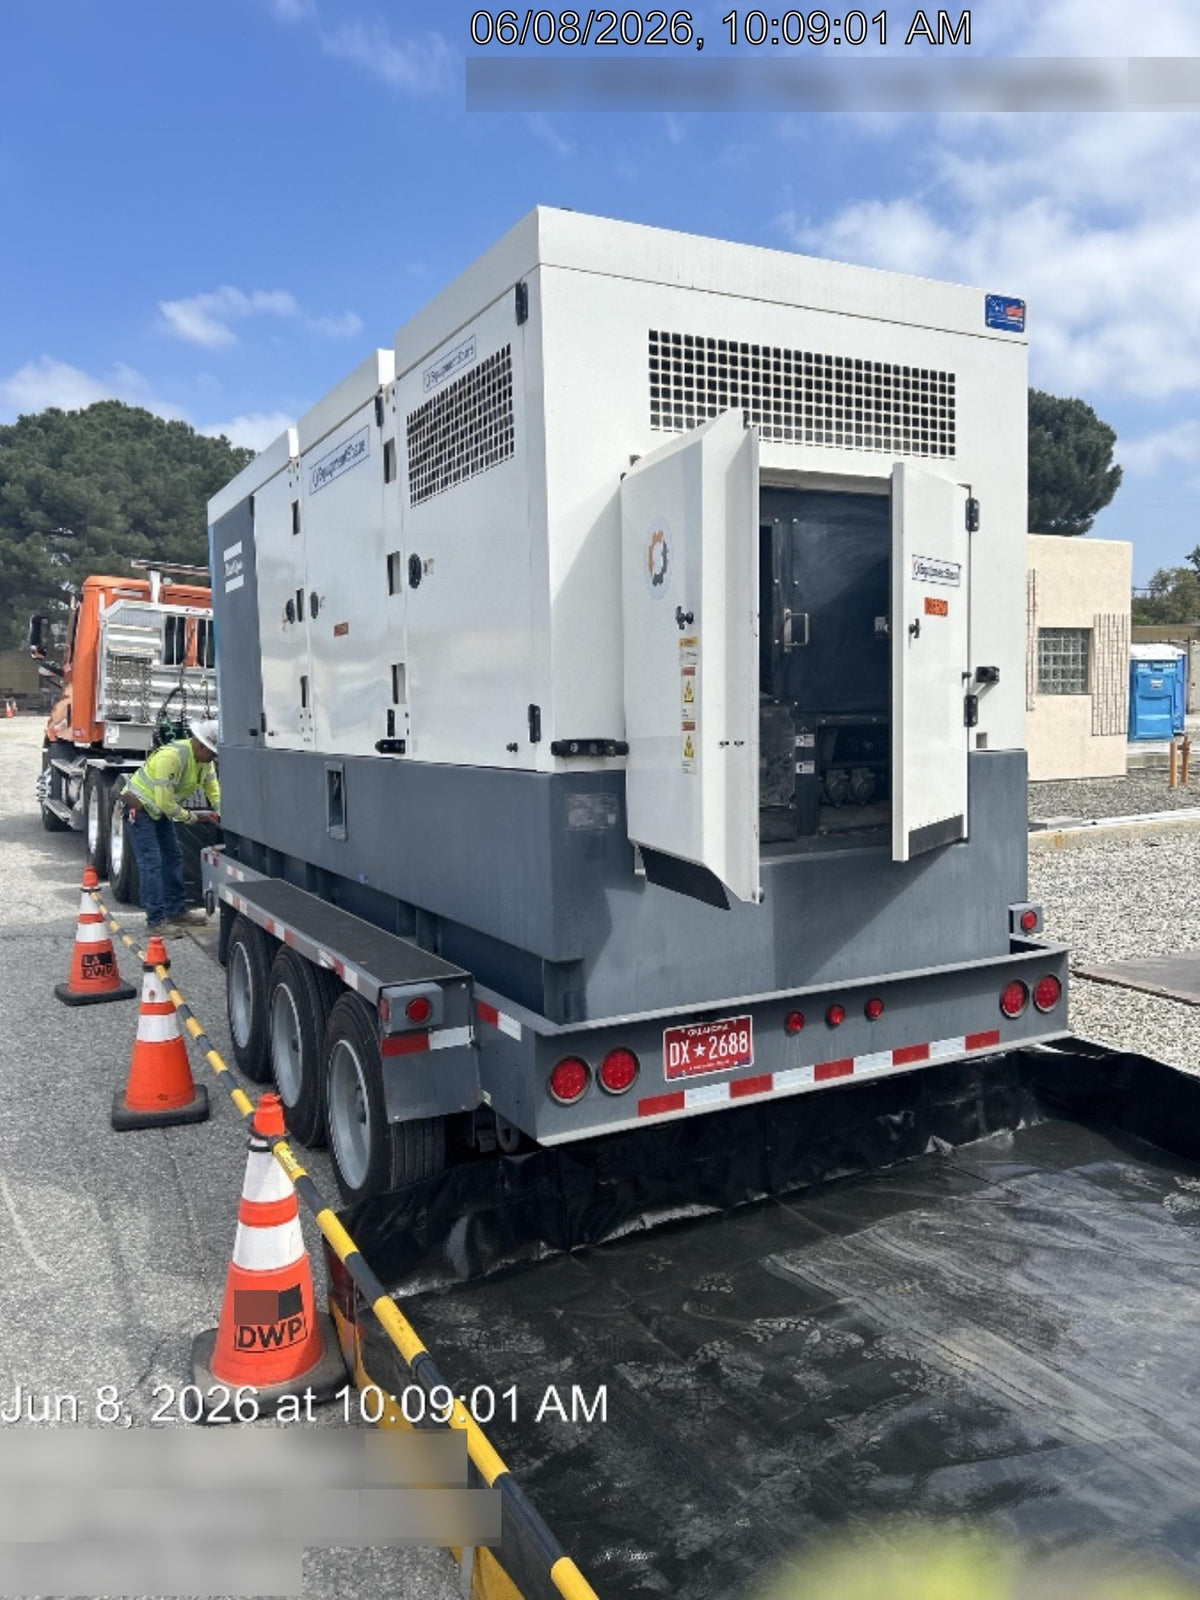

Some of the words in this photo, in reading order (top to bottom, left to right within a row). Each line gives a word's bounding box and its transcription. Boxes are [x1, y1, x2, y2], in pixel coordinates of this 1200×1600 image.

[669, 1039, 690, 1067] DX
[708, 1030, 748, 1060] 2688
[238, 1317, 302, 1348] DWP
